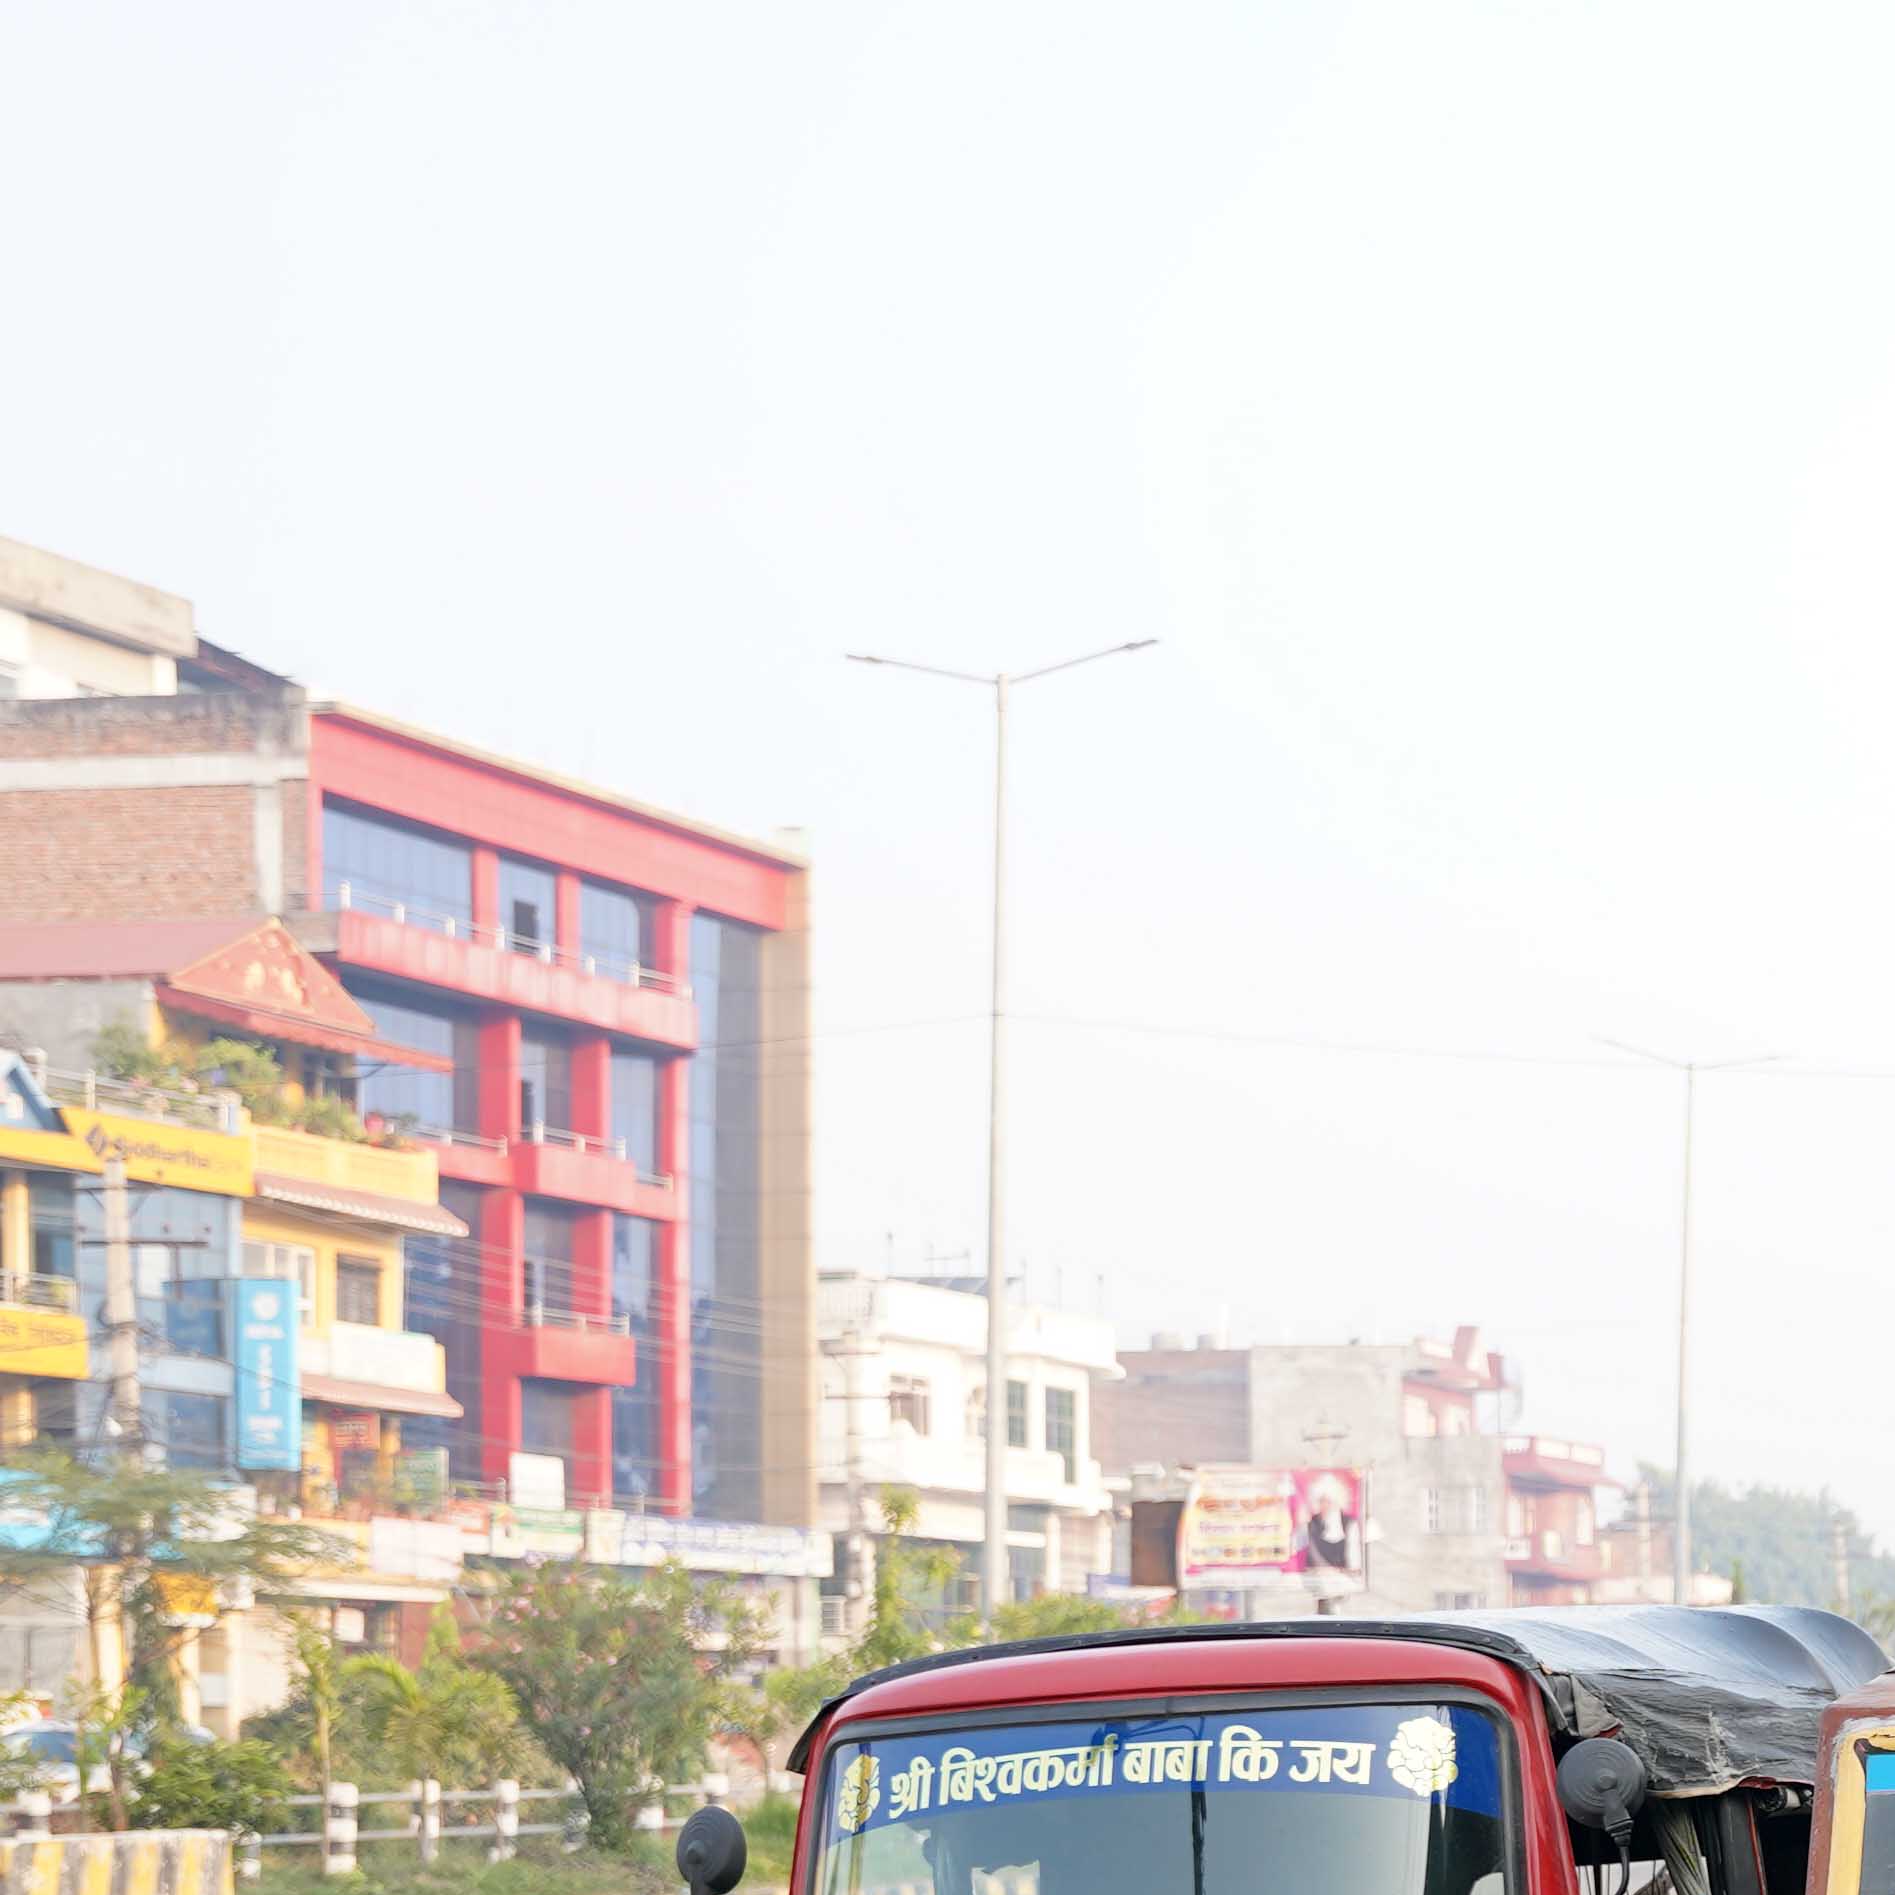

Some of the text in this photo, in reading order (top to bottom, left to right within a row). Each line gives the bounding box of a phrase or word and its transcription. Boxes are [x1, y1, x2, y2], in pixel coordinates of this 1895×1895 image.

[888, 1745, 935, 1820] श्री
[1122, 1739, 1214, 1785] बाबा
[1217, 1723, 1285, 1783] कि
[1287, 1739, 1377, 1786] जय
